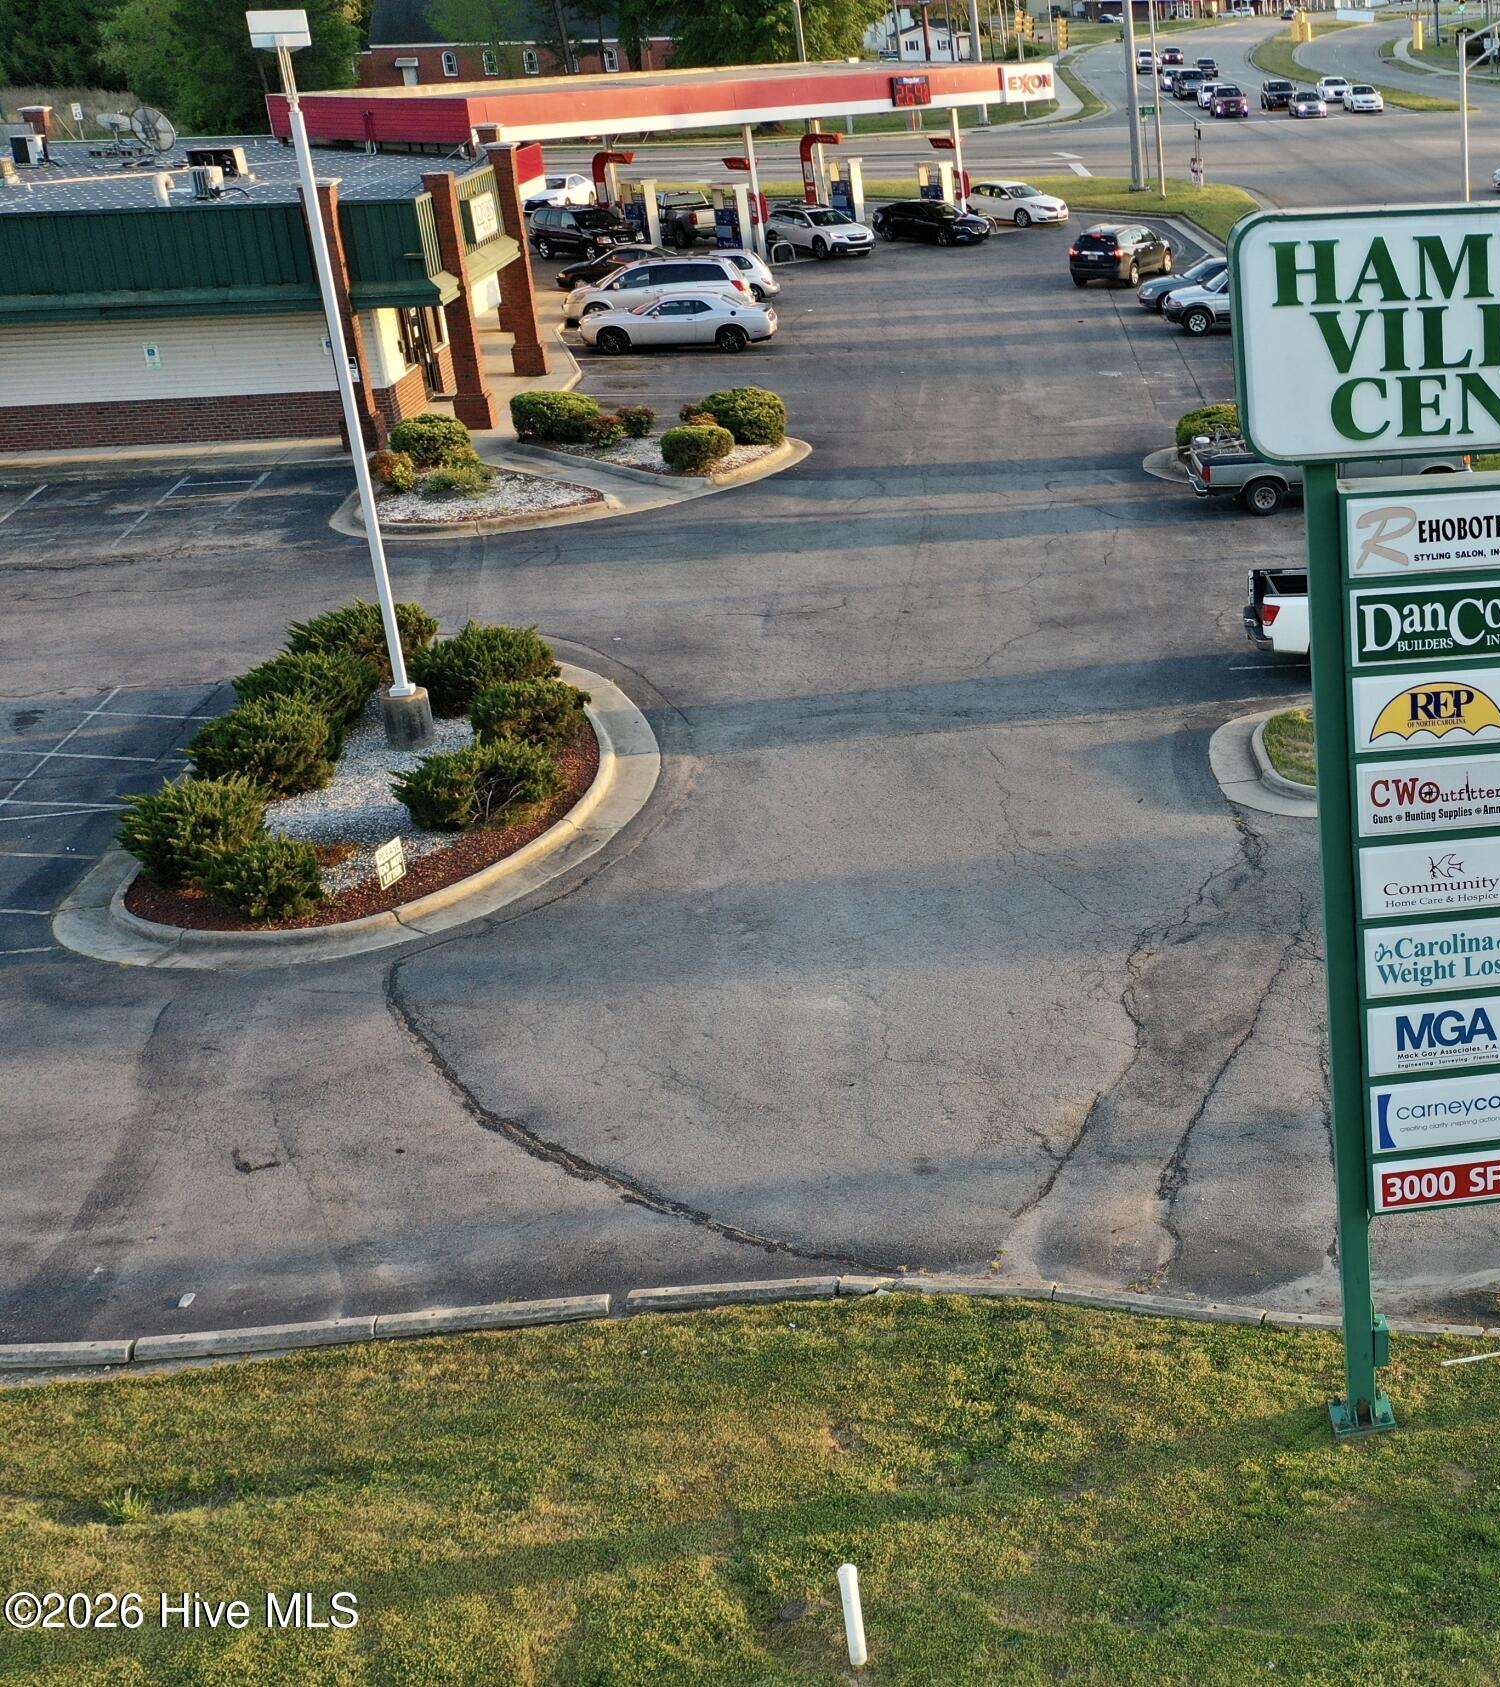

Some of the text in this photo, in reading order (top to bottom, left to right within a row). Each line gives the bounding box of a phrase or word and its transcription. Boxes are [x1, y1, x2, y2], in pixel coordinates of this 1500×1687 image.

[1008, 74, 1051, 95] EXXON
[1414, 552, 1451, 562] STYLING
[1455, 549, 1487, 559] SALON,
[1397, 637, 1454, 652] BUILDERS
[1407, 689, 1475, 721] REP
[1416, 720, 1436, 728] NORTH
[1436, 718, 1466, 726] CAROLINA
[1373, 813, 1393, 824] Guns
[1405, 810, 1436, 822] Hunting
[1438, 807, 1473, 820] Supplies
[1383, 876, 1500, 896] Community
[1385, 892, 1499, 908] Home Care & Hospice
[1394, 932, 1494, 960] Carolina
[1377, 959, 1457, 987] Weight
[1395, 1007, 1498, 1052] MGA
[1386, 1171, 1456, 1203] 3000
